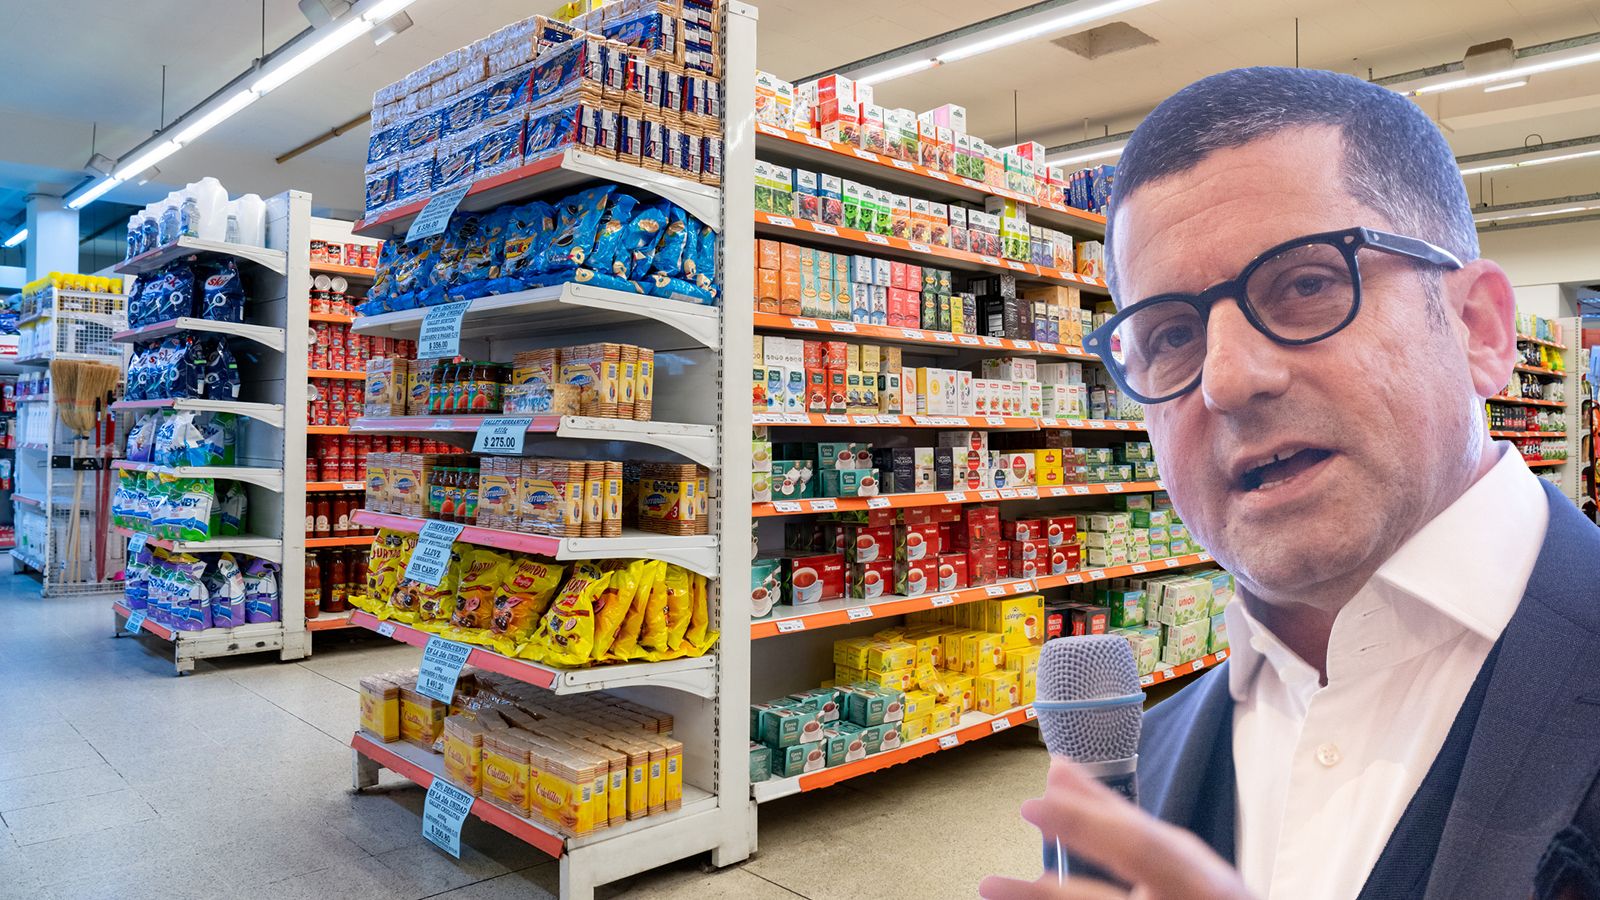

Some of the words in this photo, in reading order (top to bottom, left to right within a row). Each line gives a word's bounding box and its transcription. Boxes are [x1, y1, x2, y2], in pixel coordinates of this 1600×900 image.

[484, 436, 489, 448] $
[490, 437, 516, 448] 275.00
[424, 547, 441, 558] LLEVE
[412, 562, 421, 571] SIN
[421, 565, 440, 576] CARGO
[435, 781, 443, 790] 40%
[443, 785, 471, 805] DESCUENTO
[448, 800, 468, 815] UNIDAD
